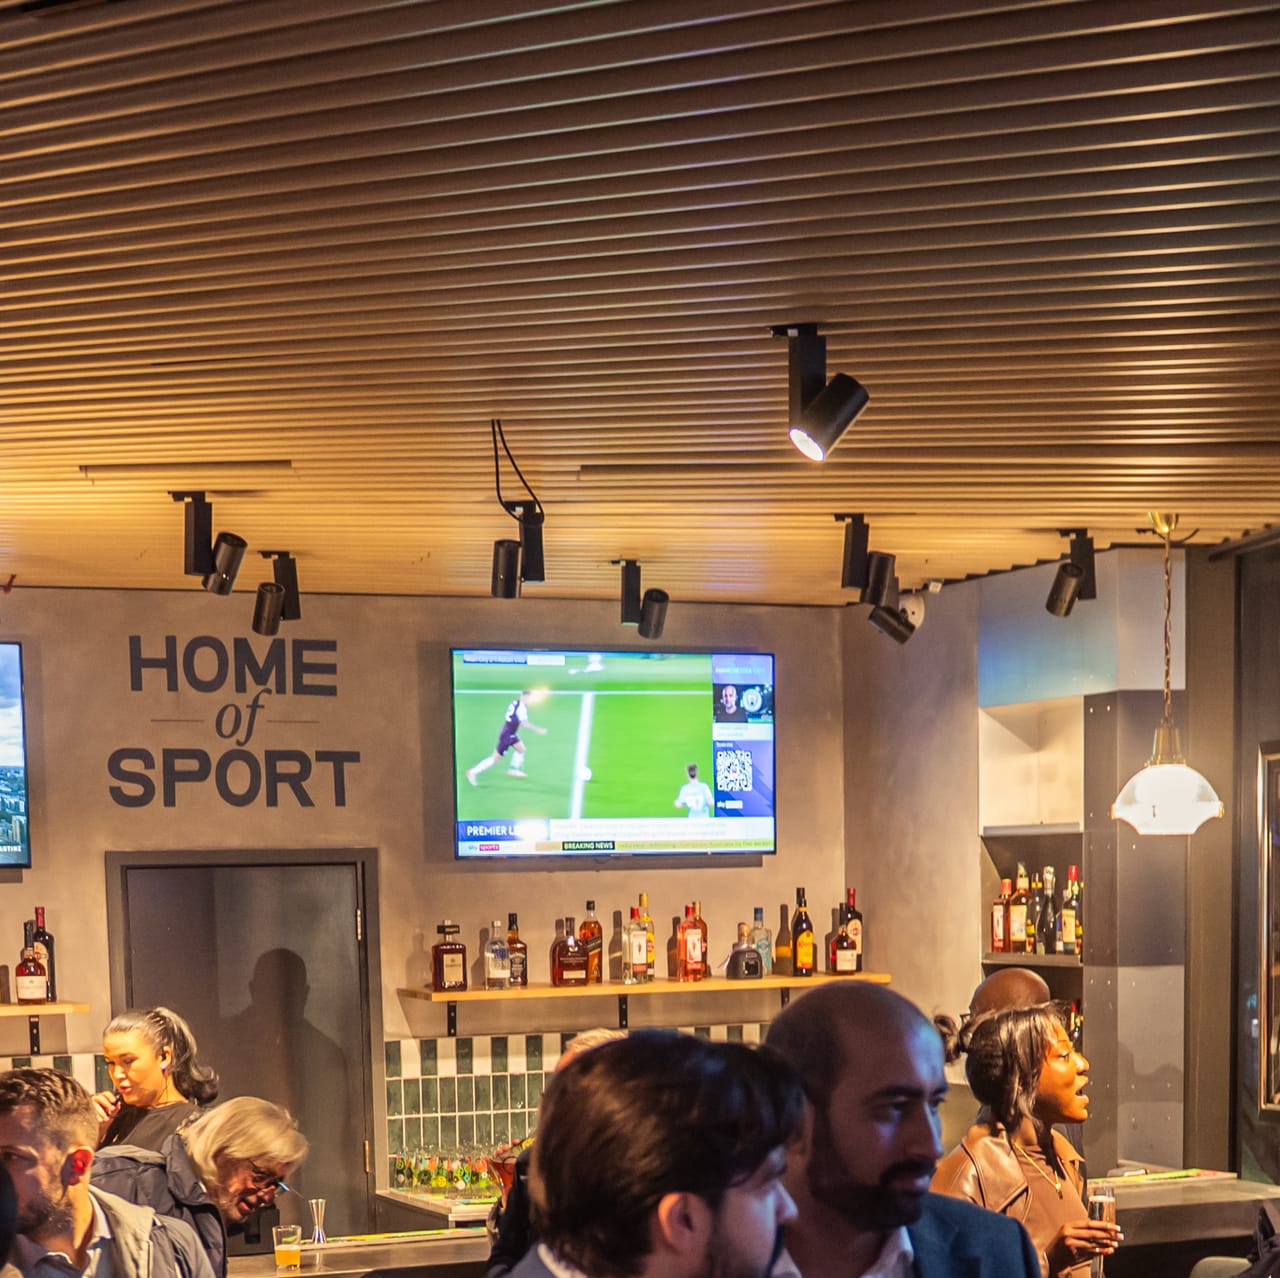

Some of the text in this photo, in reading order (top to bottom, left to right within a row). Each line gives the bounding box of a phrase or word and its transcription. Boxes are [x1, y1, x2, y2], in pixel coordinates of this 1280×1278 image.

[129, 635, 337, 696] HOME
[215, 687, 272, 747] of
[107, 747, 361, 808] SPORT
[467, 826, 508, 836] PREMIER
[564, 842, 594, 850] BREAKING
